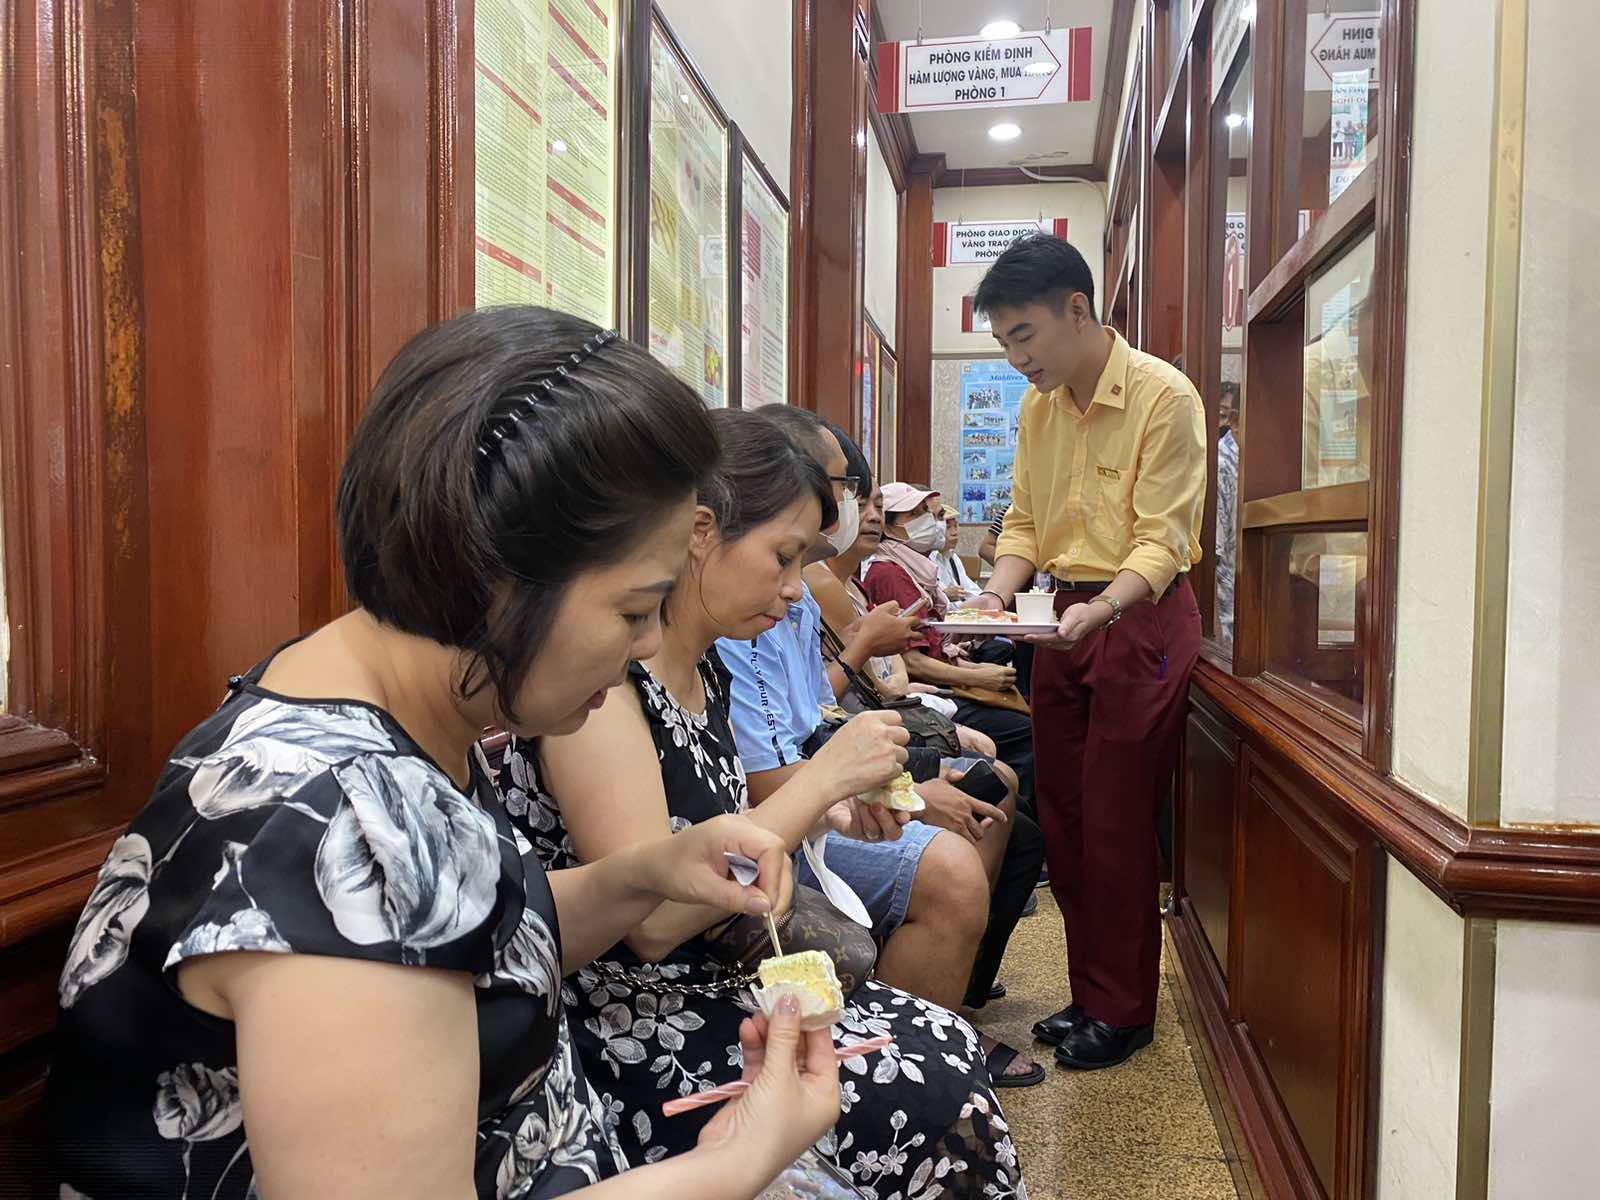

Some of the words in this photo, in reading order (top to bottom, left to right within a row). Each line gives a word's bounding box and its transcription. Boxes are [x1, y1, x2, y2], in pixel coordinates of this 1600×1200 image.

[930, 49, 970, 64] PHÒNG
[974, 43, 1001, 62] KIỂM
[1004, 46, 1033, 62] ĐỊNH
[909, 69, 931, 85] HÀM
[933, 68, 965, 86] LƯỢNG
[968, 65, 998, 82] VÀNG,
[1001, 66, 1022, 79] MUA
[955, 86, 996, 101] PHÒNG
[1001, 86, 1006, 98] 1
[956, 228, 986, 238] PHÒNG
[988, 229, 1010, 237] GIAO
[962, 239, 986, 248] VÀNG
